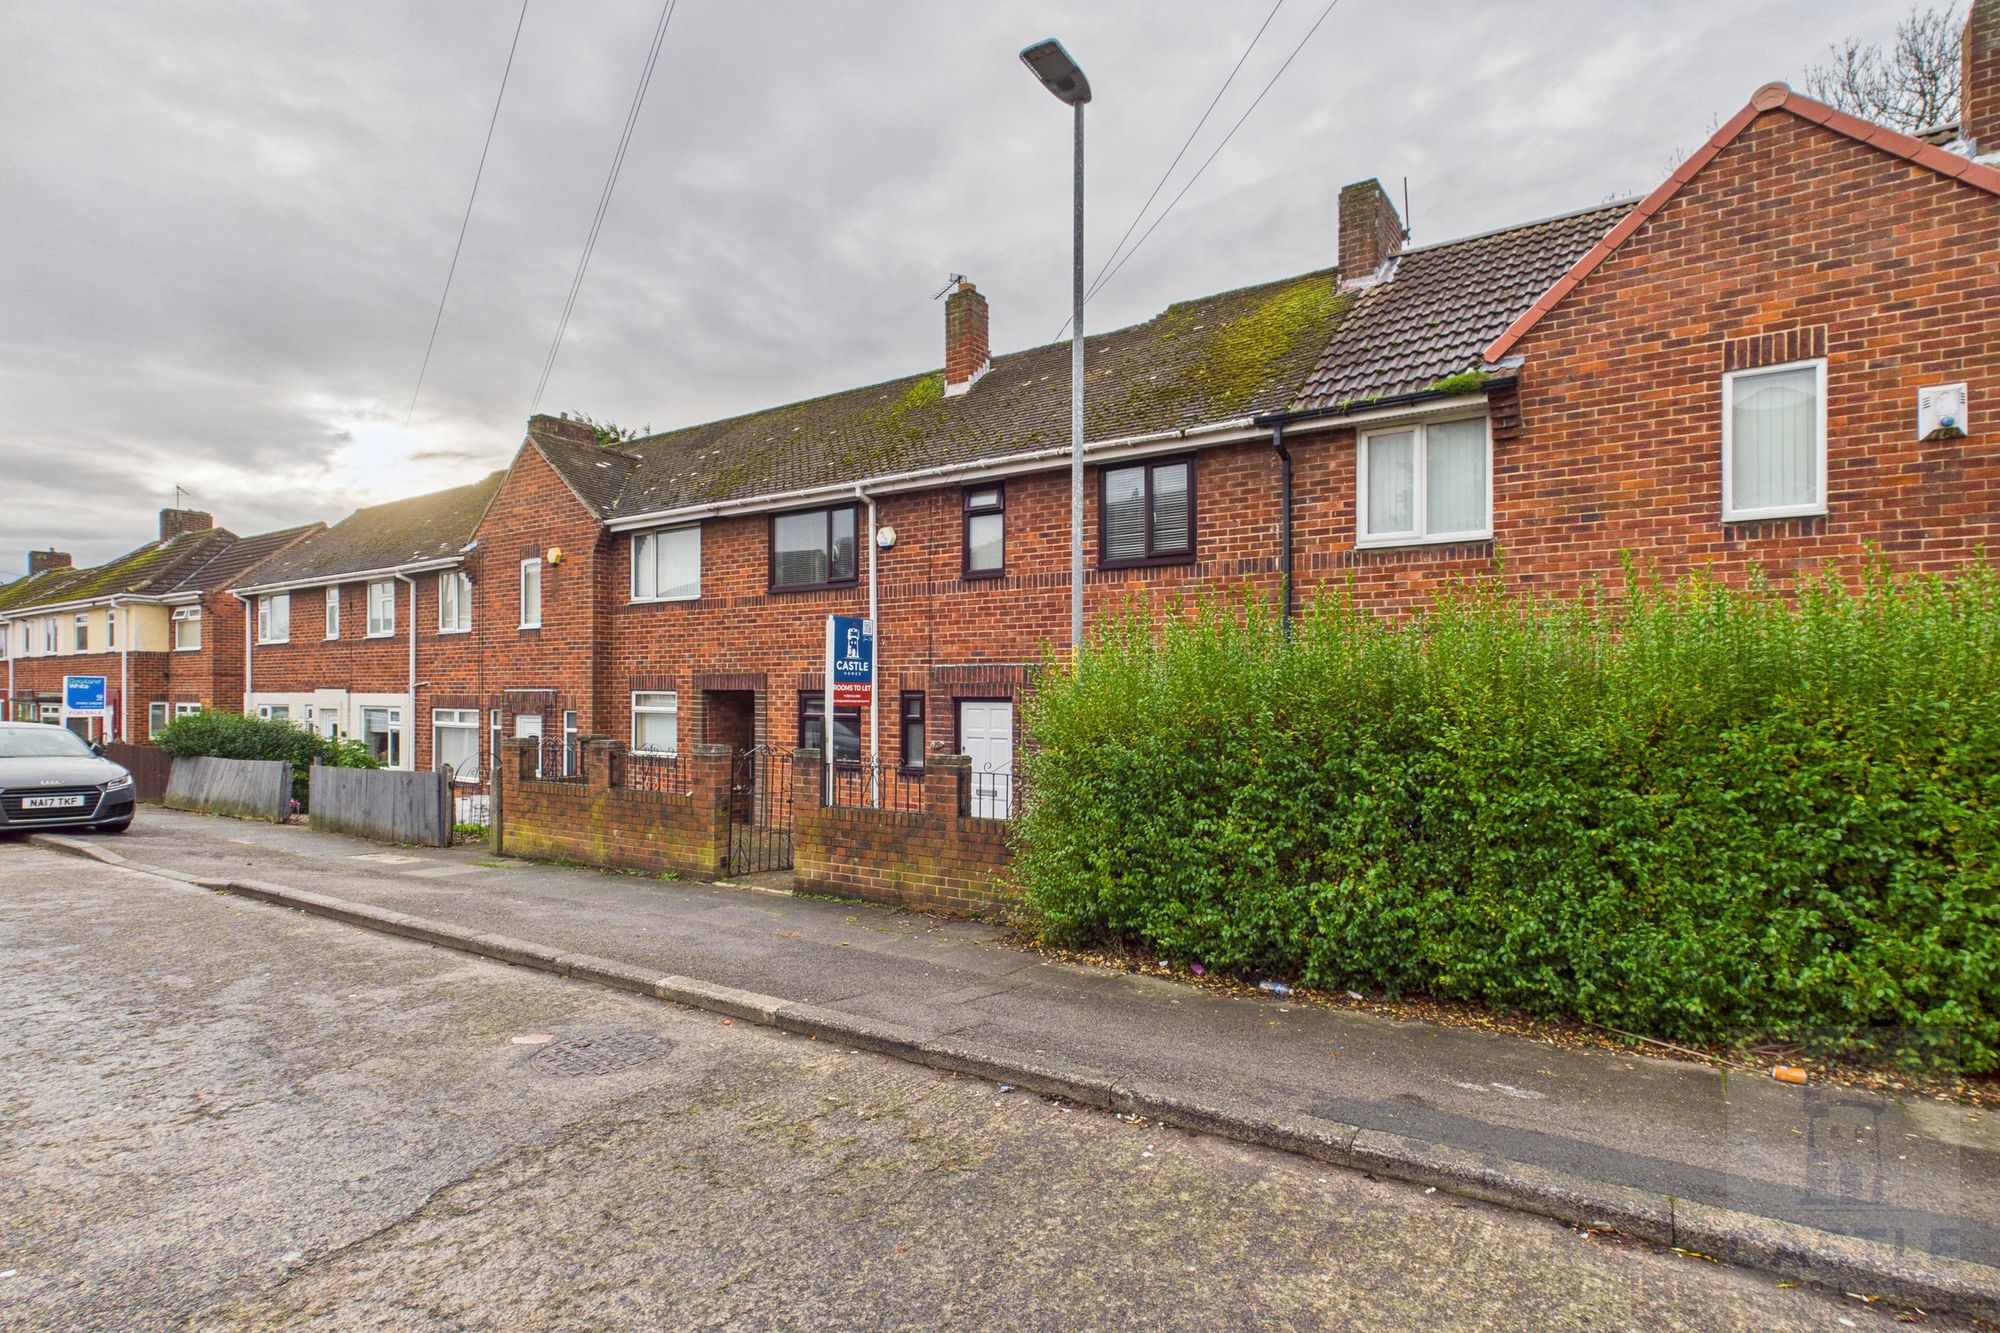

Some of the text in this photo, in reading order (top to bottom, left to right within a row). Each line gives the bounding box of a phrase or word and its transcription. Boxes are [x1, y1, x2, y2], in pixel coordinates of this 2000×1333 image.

[836, 660, 869, 671] CASTLE
[30, 797, 78, 807] NA17 TKF
